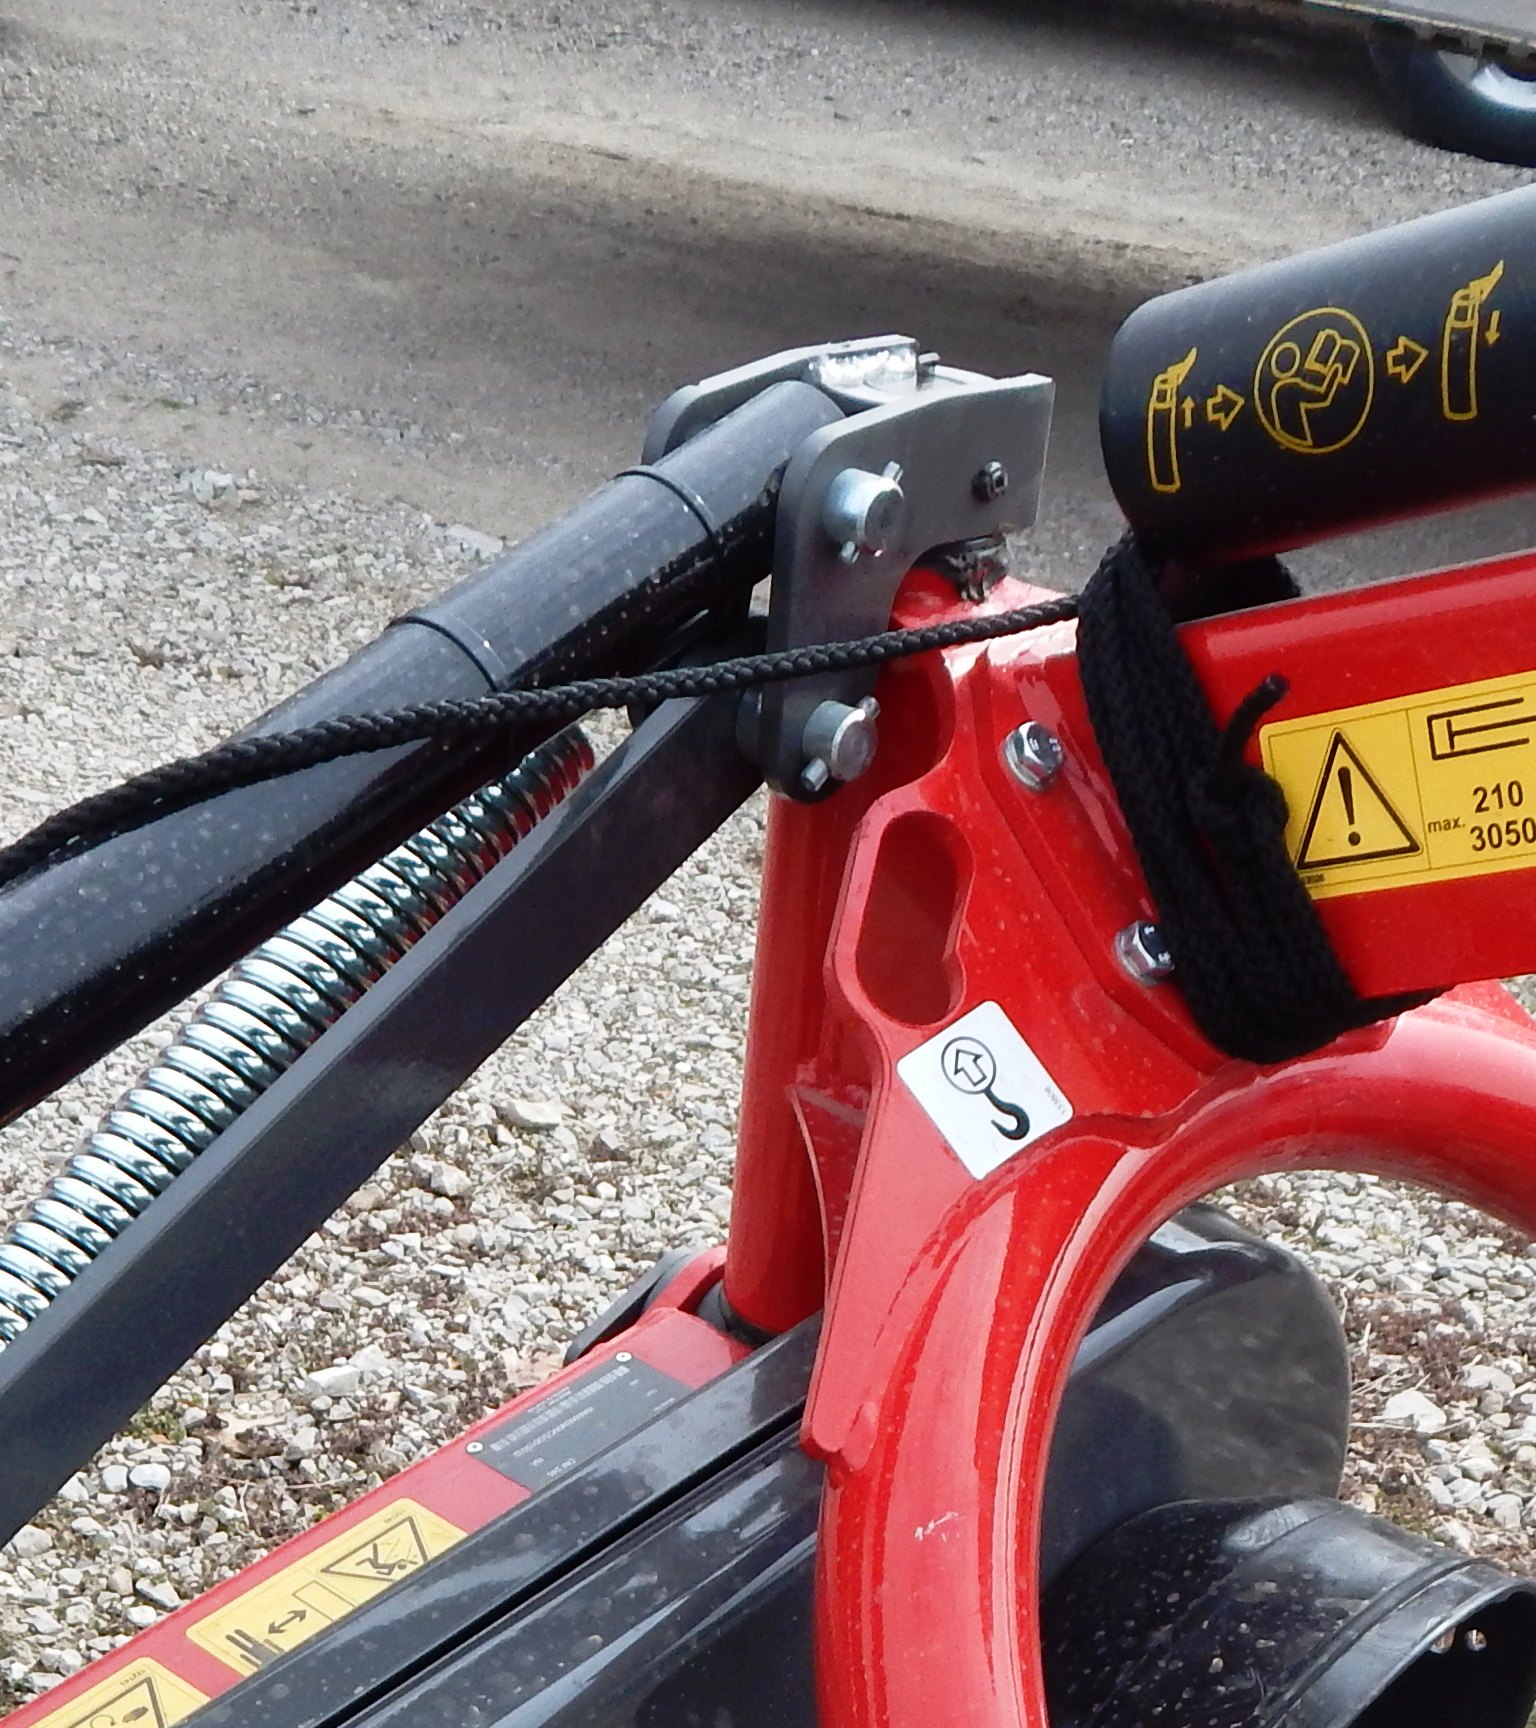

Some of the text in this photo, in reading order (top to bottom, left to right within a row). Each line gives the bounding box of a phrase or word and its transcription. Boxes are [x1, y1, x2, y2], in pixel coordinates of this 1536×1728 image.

[1472, 780, 1523, 813] 210
[1427, 816, 1466, 834] max.
[1470, 817, 1536, 851] 3050
